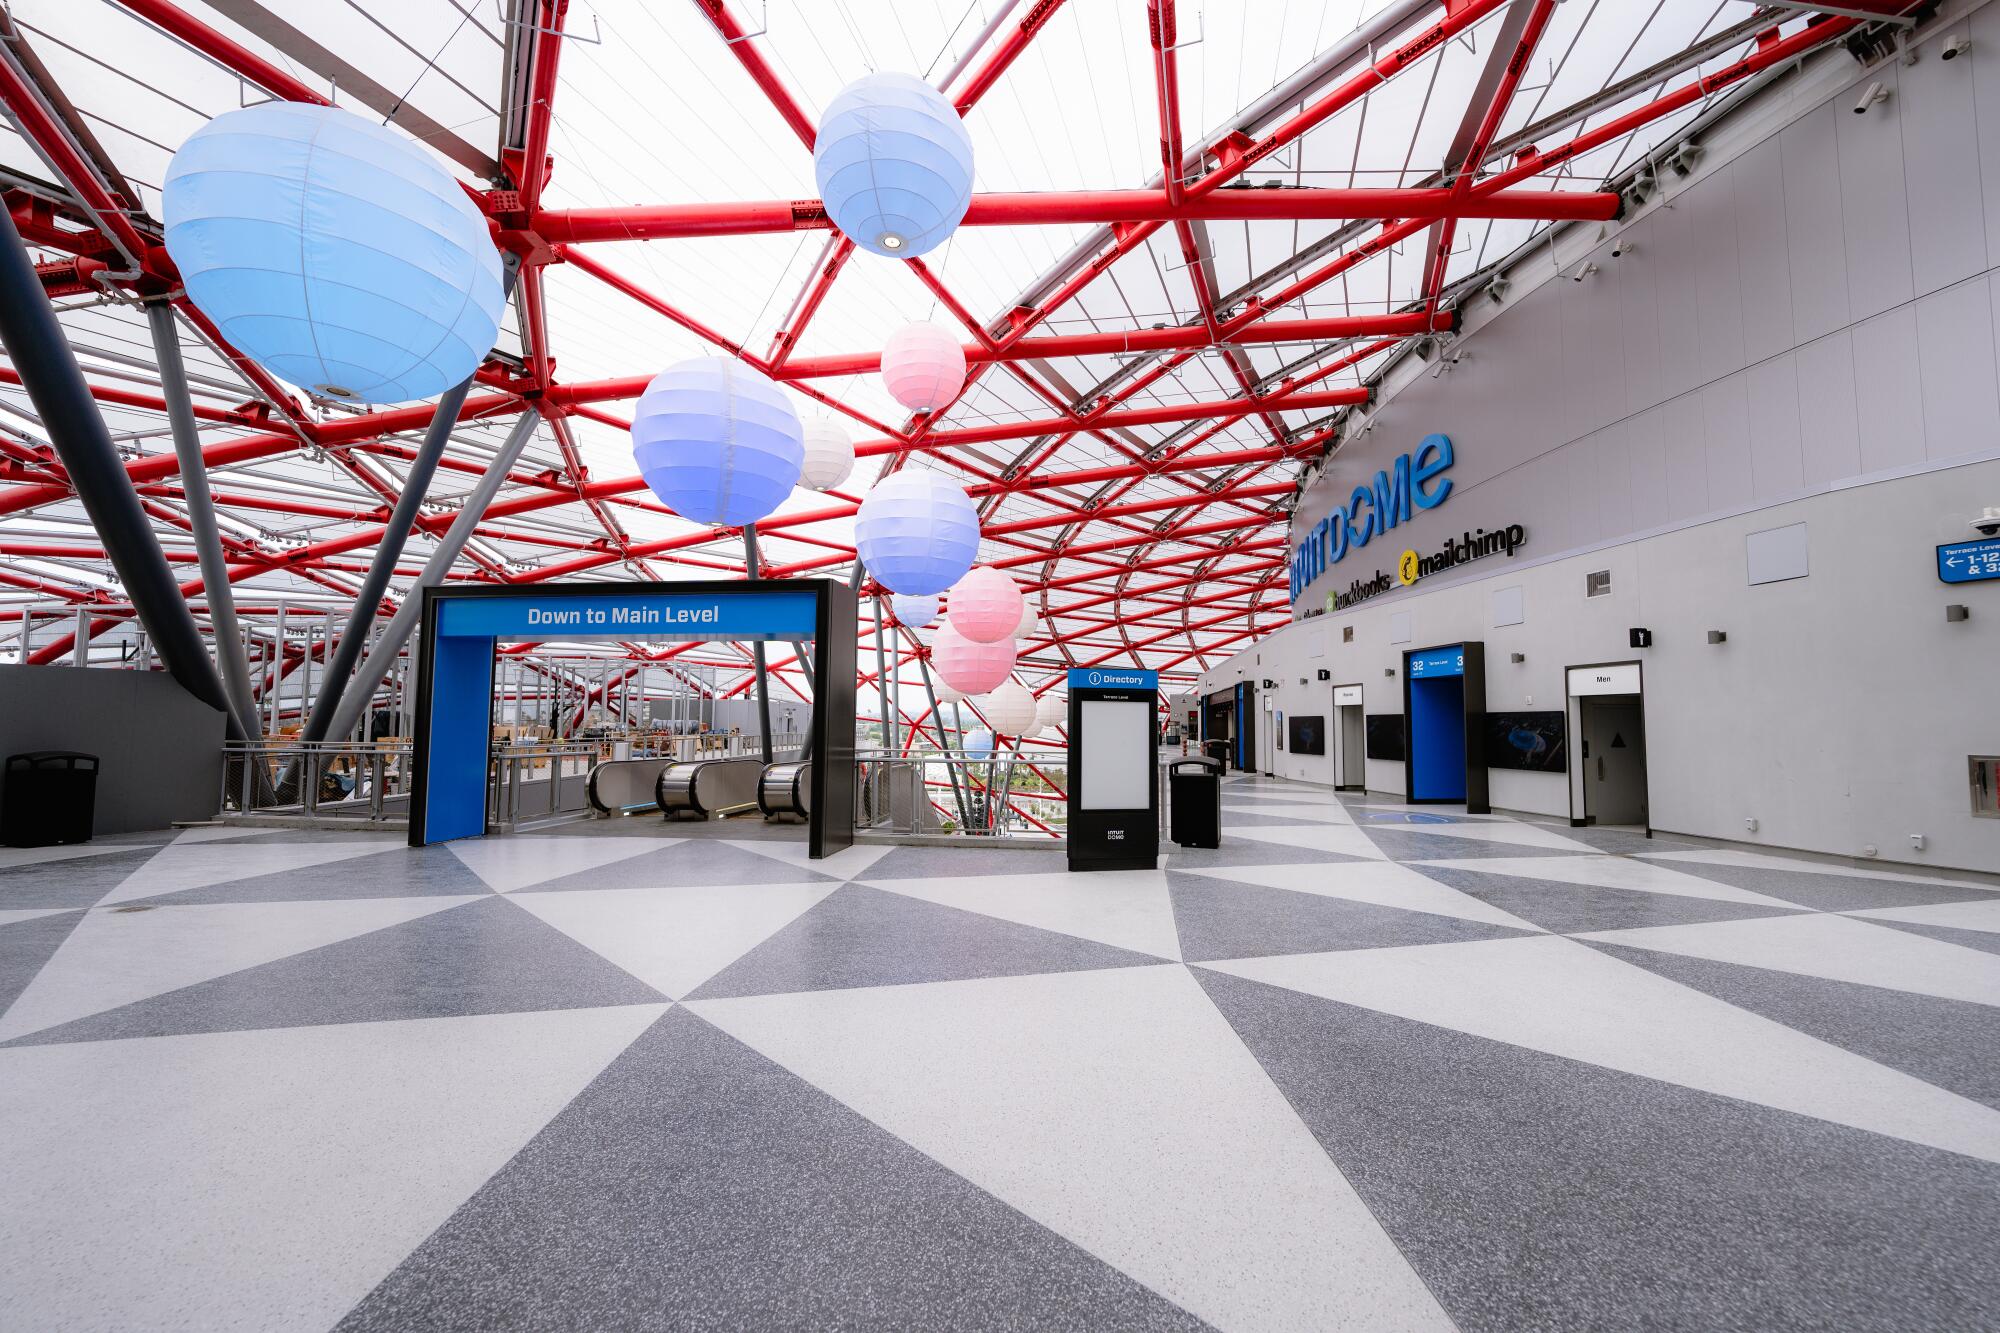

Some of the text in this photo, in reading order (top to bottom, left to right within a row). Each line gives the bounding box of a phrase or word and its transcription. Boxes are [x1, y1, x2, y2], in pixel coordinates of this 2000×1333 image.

[1418, 523, 1525, 575] mailchimp
[1968, 565, 1981, 575] &
[528, 605, 719, 625] Down to Main Level
[1412, 660, 1424, 671] 32
[1103, 675, 1143, 685] Directory
[1596, 675, 1611, 683] Men
